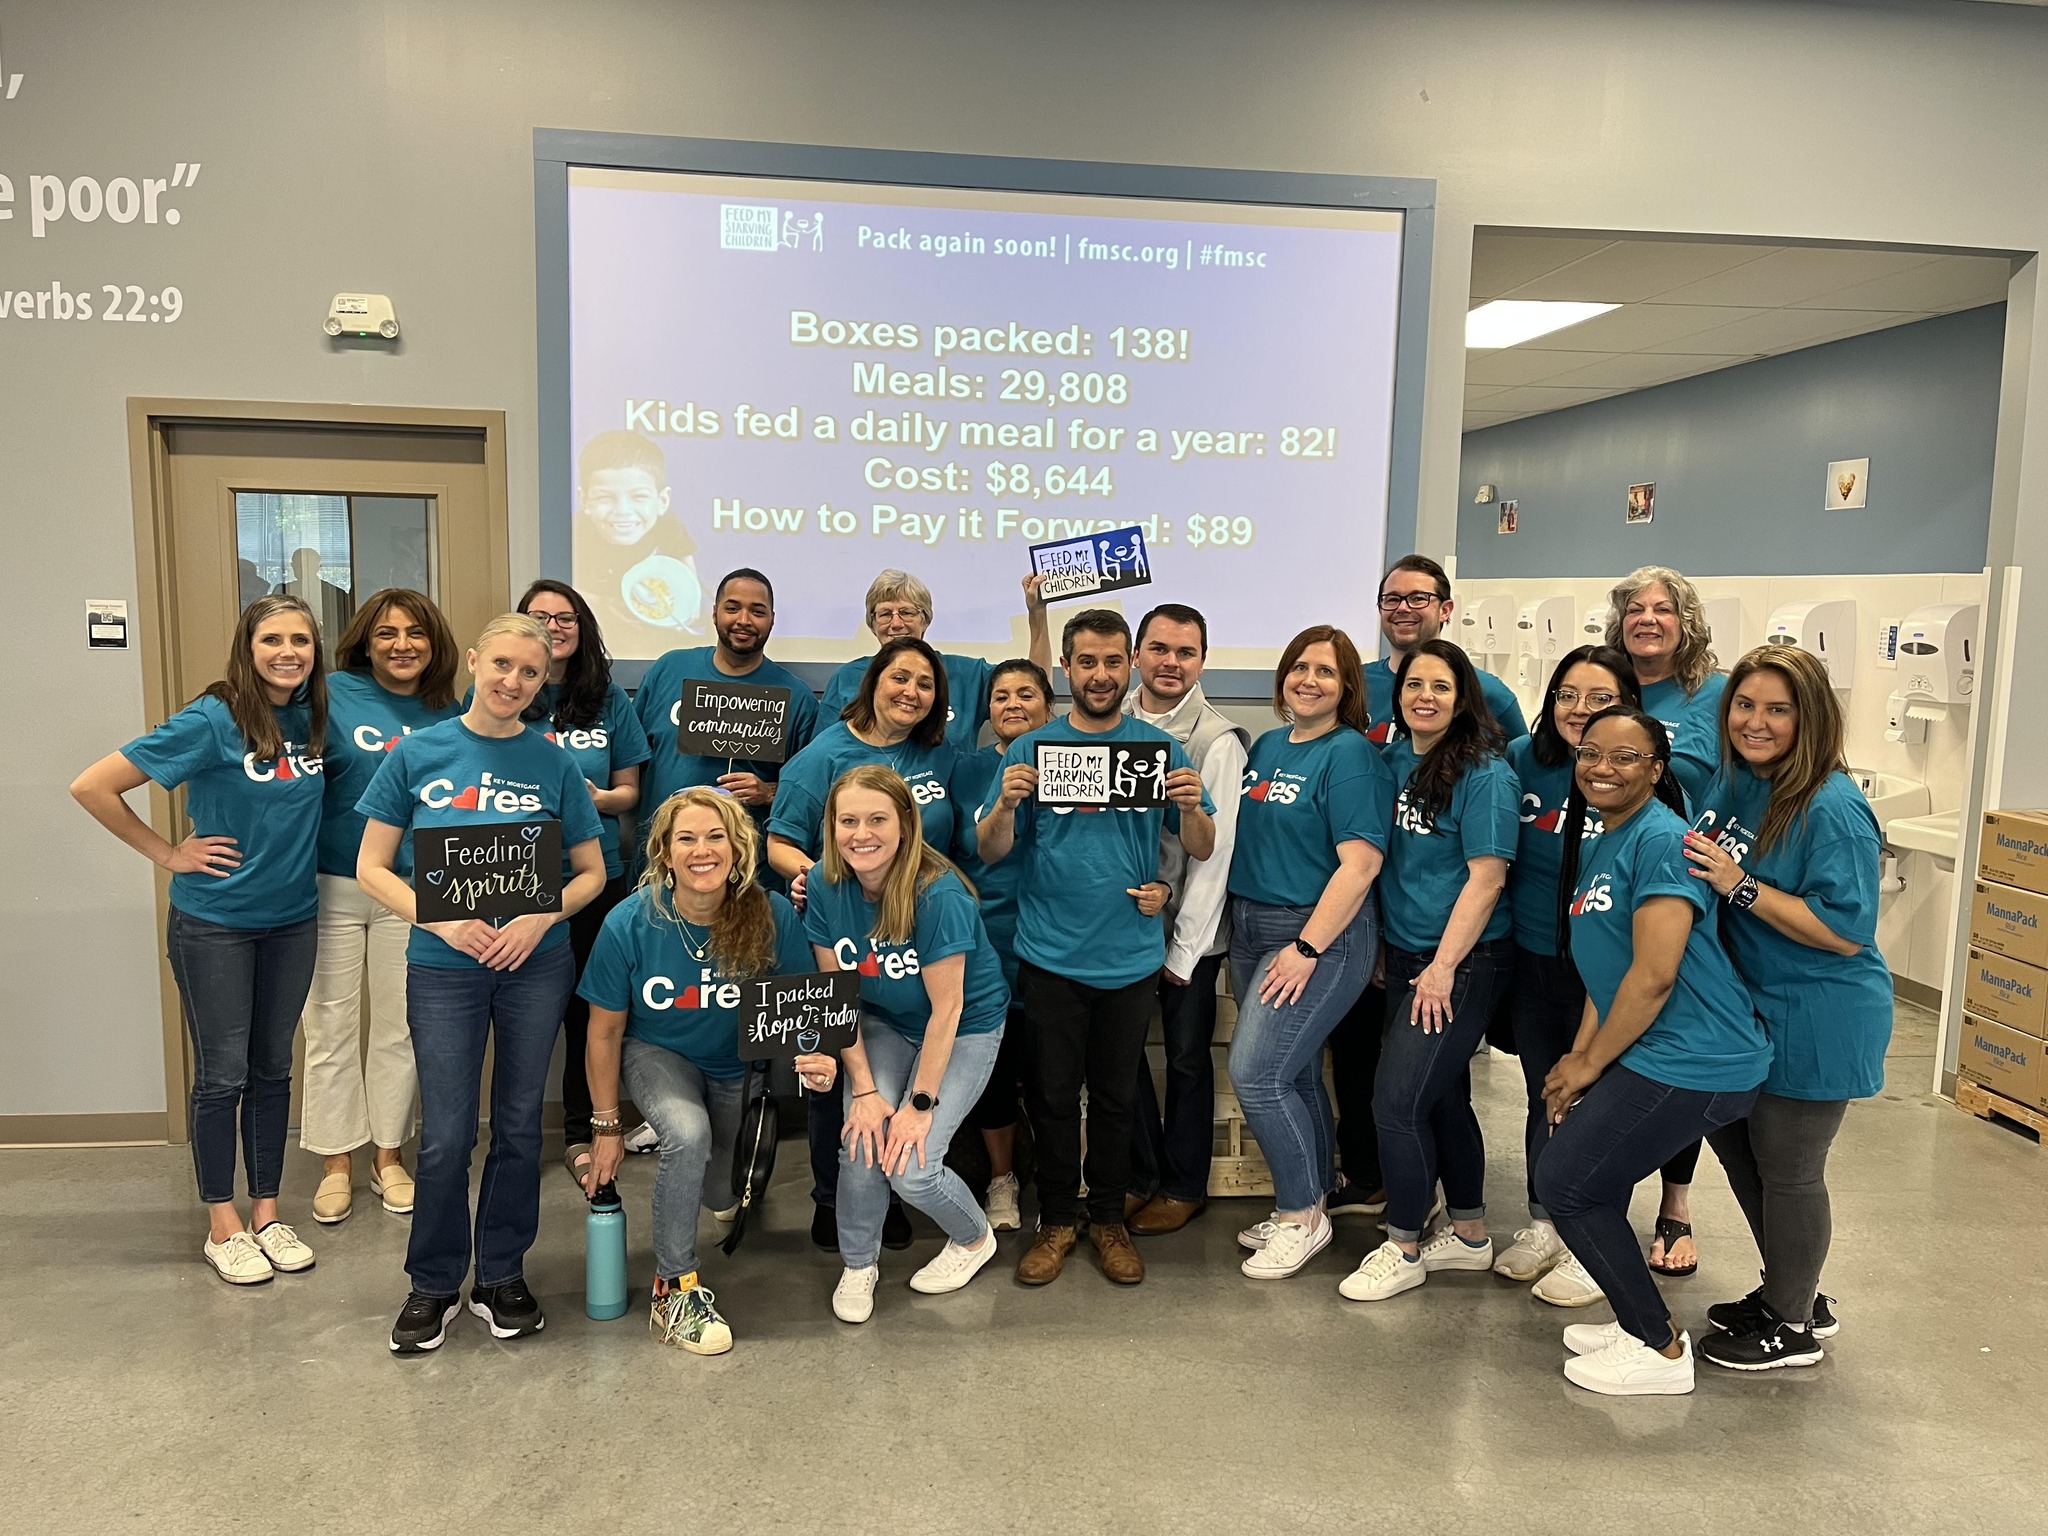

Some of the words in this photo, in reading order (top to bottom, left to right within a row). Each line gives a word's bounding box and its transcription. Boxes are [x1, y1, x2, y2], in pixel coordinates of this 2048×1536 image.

[725, 207, 754, 222] FEED
[756, 209, 772, 223] MY
[725, 221, 772, 236] STARVING
[725, 234, 772, 248] CHILDREN
[858, 225, 911, 250] Pack
[919, 231, 985, 258] again
[993, 236, 1056, 258] soon!
[1078, 237, 1179, 270] fmsc.org
[1200, 244, 1267, 268] #fmsc
[102, 284, 183, 323] 22:9
[789, 310, 919, 349] Boxes
[933, 321, 1092, 357] packed:
[1108, 326, 1189, 360] 138!
[852, 362, 985, 399] Meals:
[999, 368, 1128, 407] 29,808
[624, 399, 720, 435] Kids
[733, 403, 798, 438] fed
[813, 414, 836, 440] a
[850, 410, 948, 452] daily
[960, 417, 1054, 449] meal
[1068, 418, 1124, 451] for
[1135, 429, 1158, 453] a
[1170, 430, 1265, 461] year:
[1279, 426, 1337, 458] 82!
[864, 457, 970, 492] Cost:
[986, 460, 1113, 499] $8,644
[712, 498, 805, 531] How
[817, 503, 857, 534] to
[872, 504, 947, 545] Pay
[958, 507, 983, 538] it
[1186, 512, 1253, 548] $89
[1039, 550, 1072, 570] FEED
[1075, 549, 1089, 562] MY
[1044, 573, 1095, 594] CHILDREN
[695, 685, 786, 724] Empowering
[543, 728, 608, 750] res
[688, 718, 784, 745] communities
[1043, 769, 1103, 784] STARVING
[1044, 752, 1082, 769] FEED
[1086, 755, 1104, 770] MY
[493, 777, 505, 786] KEY
[1043, 783, 1105, 798] CHILDREN
[444, 834, 537, 878] Feeding
[1996, 832, 2048, 858] MannaPack
[442, 863, 544, 911] spirits
[1986, 901, 2038, 929] MannaPack
[642, 975, 741, 1011] Care
[755, 981, 772, 1008] I
[776, 977, 834, 1016] packed
[1980, 968, 2032, 999] MannaPack
[750, 1004, 812, 1044] hope
[821, 1003, 859, 1032] today
[1974, 1034, 2027, 1067] MannaPack
